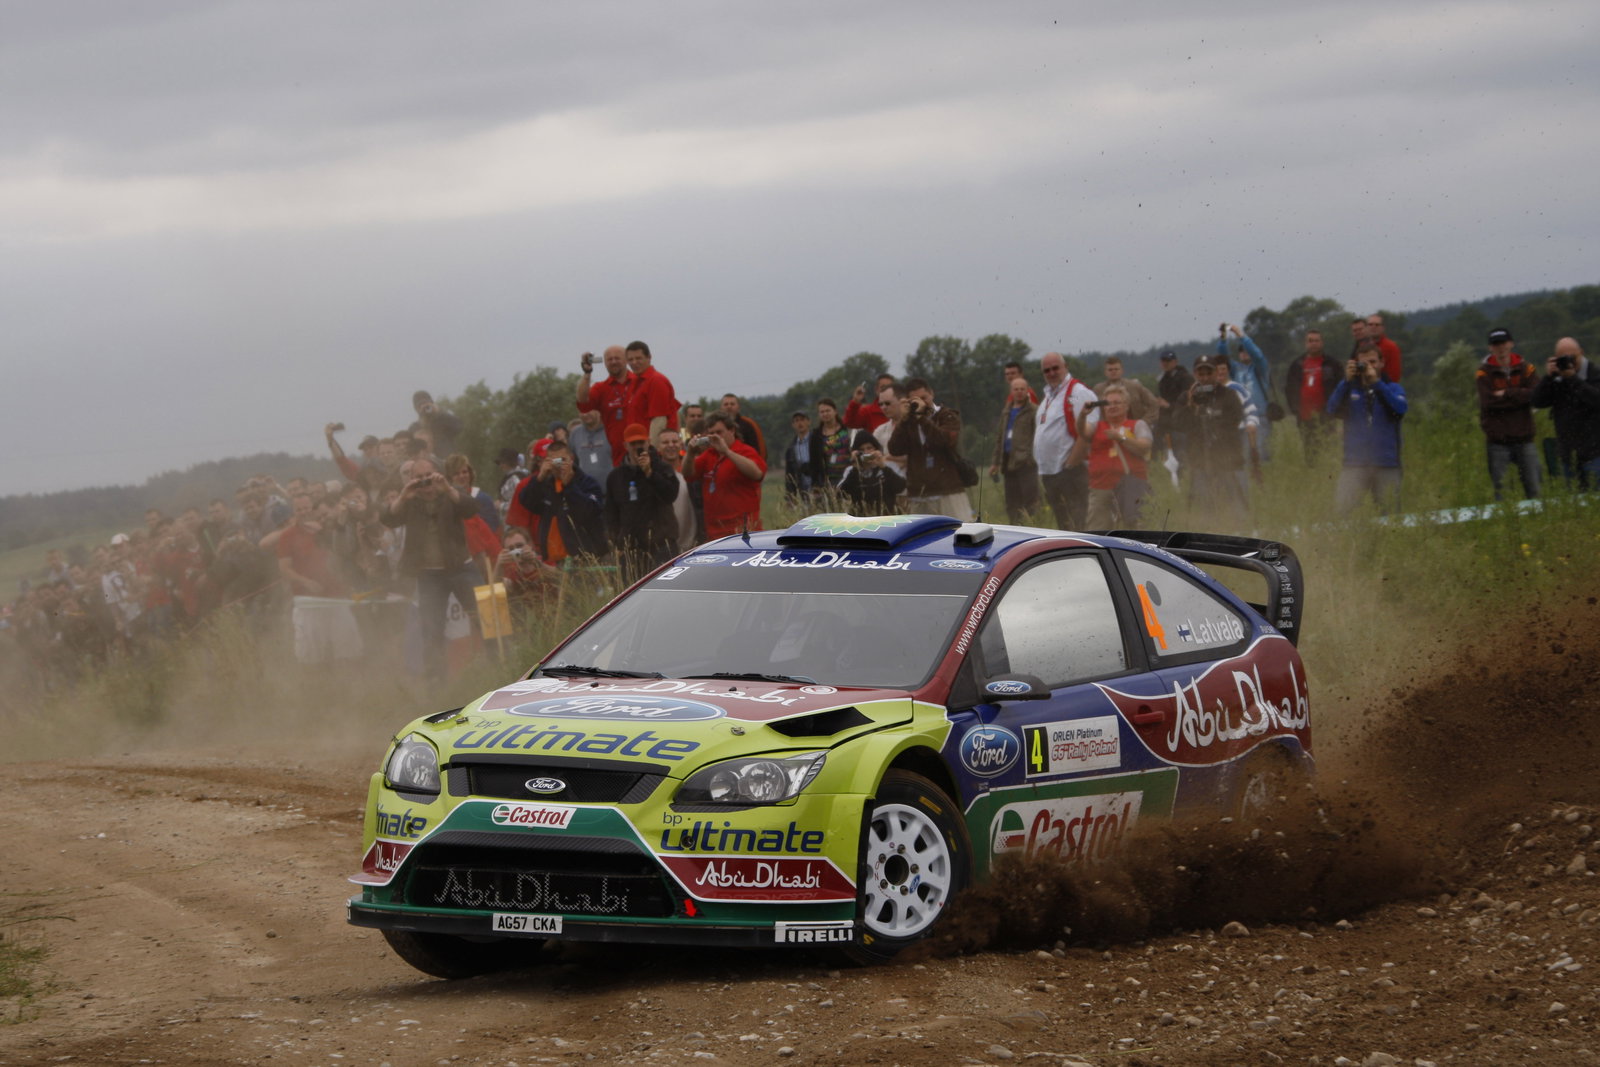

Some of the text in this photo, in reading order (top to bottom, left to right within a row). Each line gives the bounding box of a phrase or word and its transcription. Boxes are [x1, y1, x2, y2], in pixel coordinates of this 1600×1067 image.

[956, 576, 1000, 655] www.wrcford.com
[1137, 584, 1168, 650] 4
[1188, 615, 1244, 644] Latvala
[994, 682, 1023, 692] Ford
[539, 697, 688, 717] Ford
[475, 719, 502, 729] bp
[1053, 728, 1103, 742] ORLEN Platinum
[453, 724, 701, 760] ultimate
[971, 733, 1008, 768] Ford
[1032, 729, 1043, 772] 4
[1068, 741, 1089, 761] Rally
[1088, 737, 1118, 757] Poland
[532, 779, 558, 789] Ford
[510, 807, 569, 825] Castrol
[663, 812, 683, 825] bp
[661, 821, 824, 852] ultimate
[1025, 802, 1132, 865] Castrol
[498, 916, 557, 932] AG57 CKA
[774, 920, 855, 943] PIRELLI
